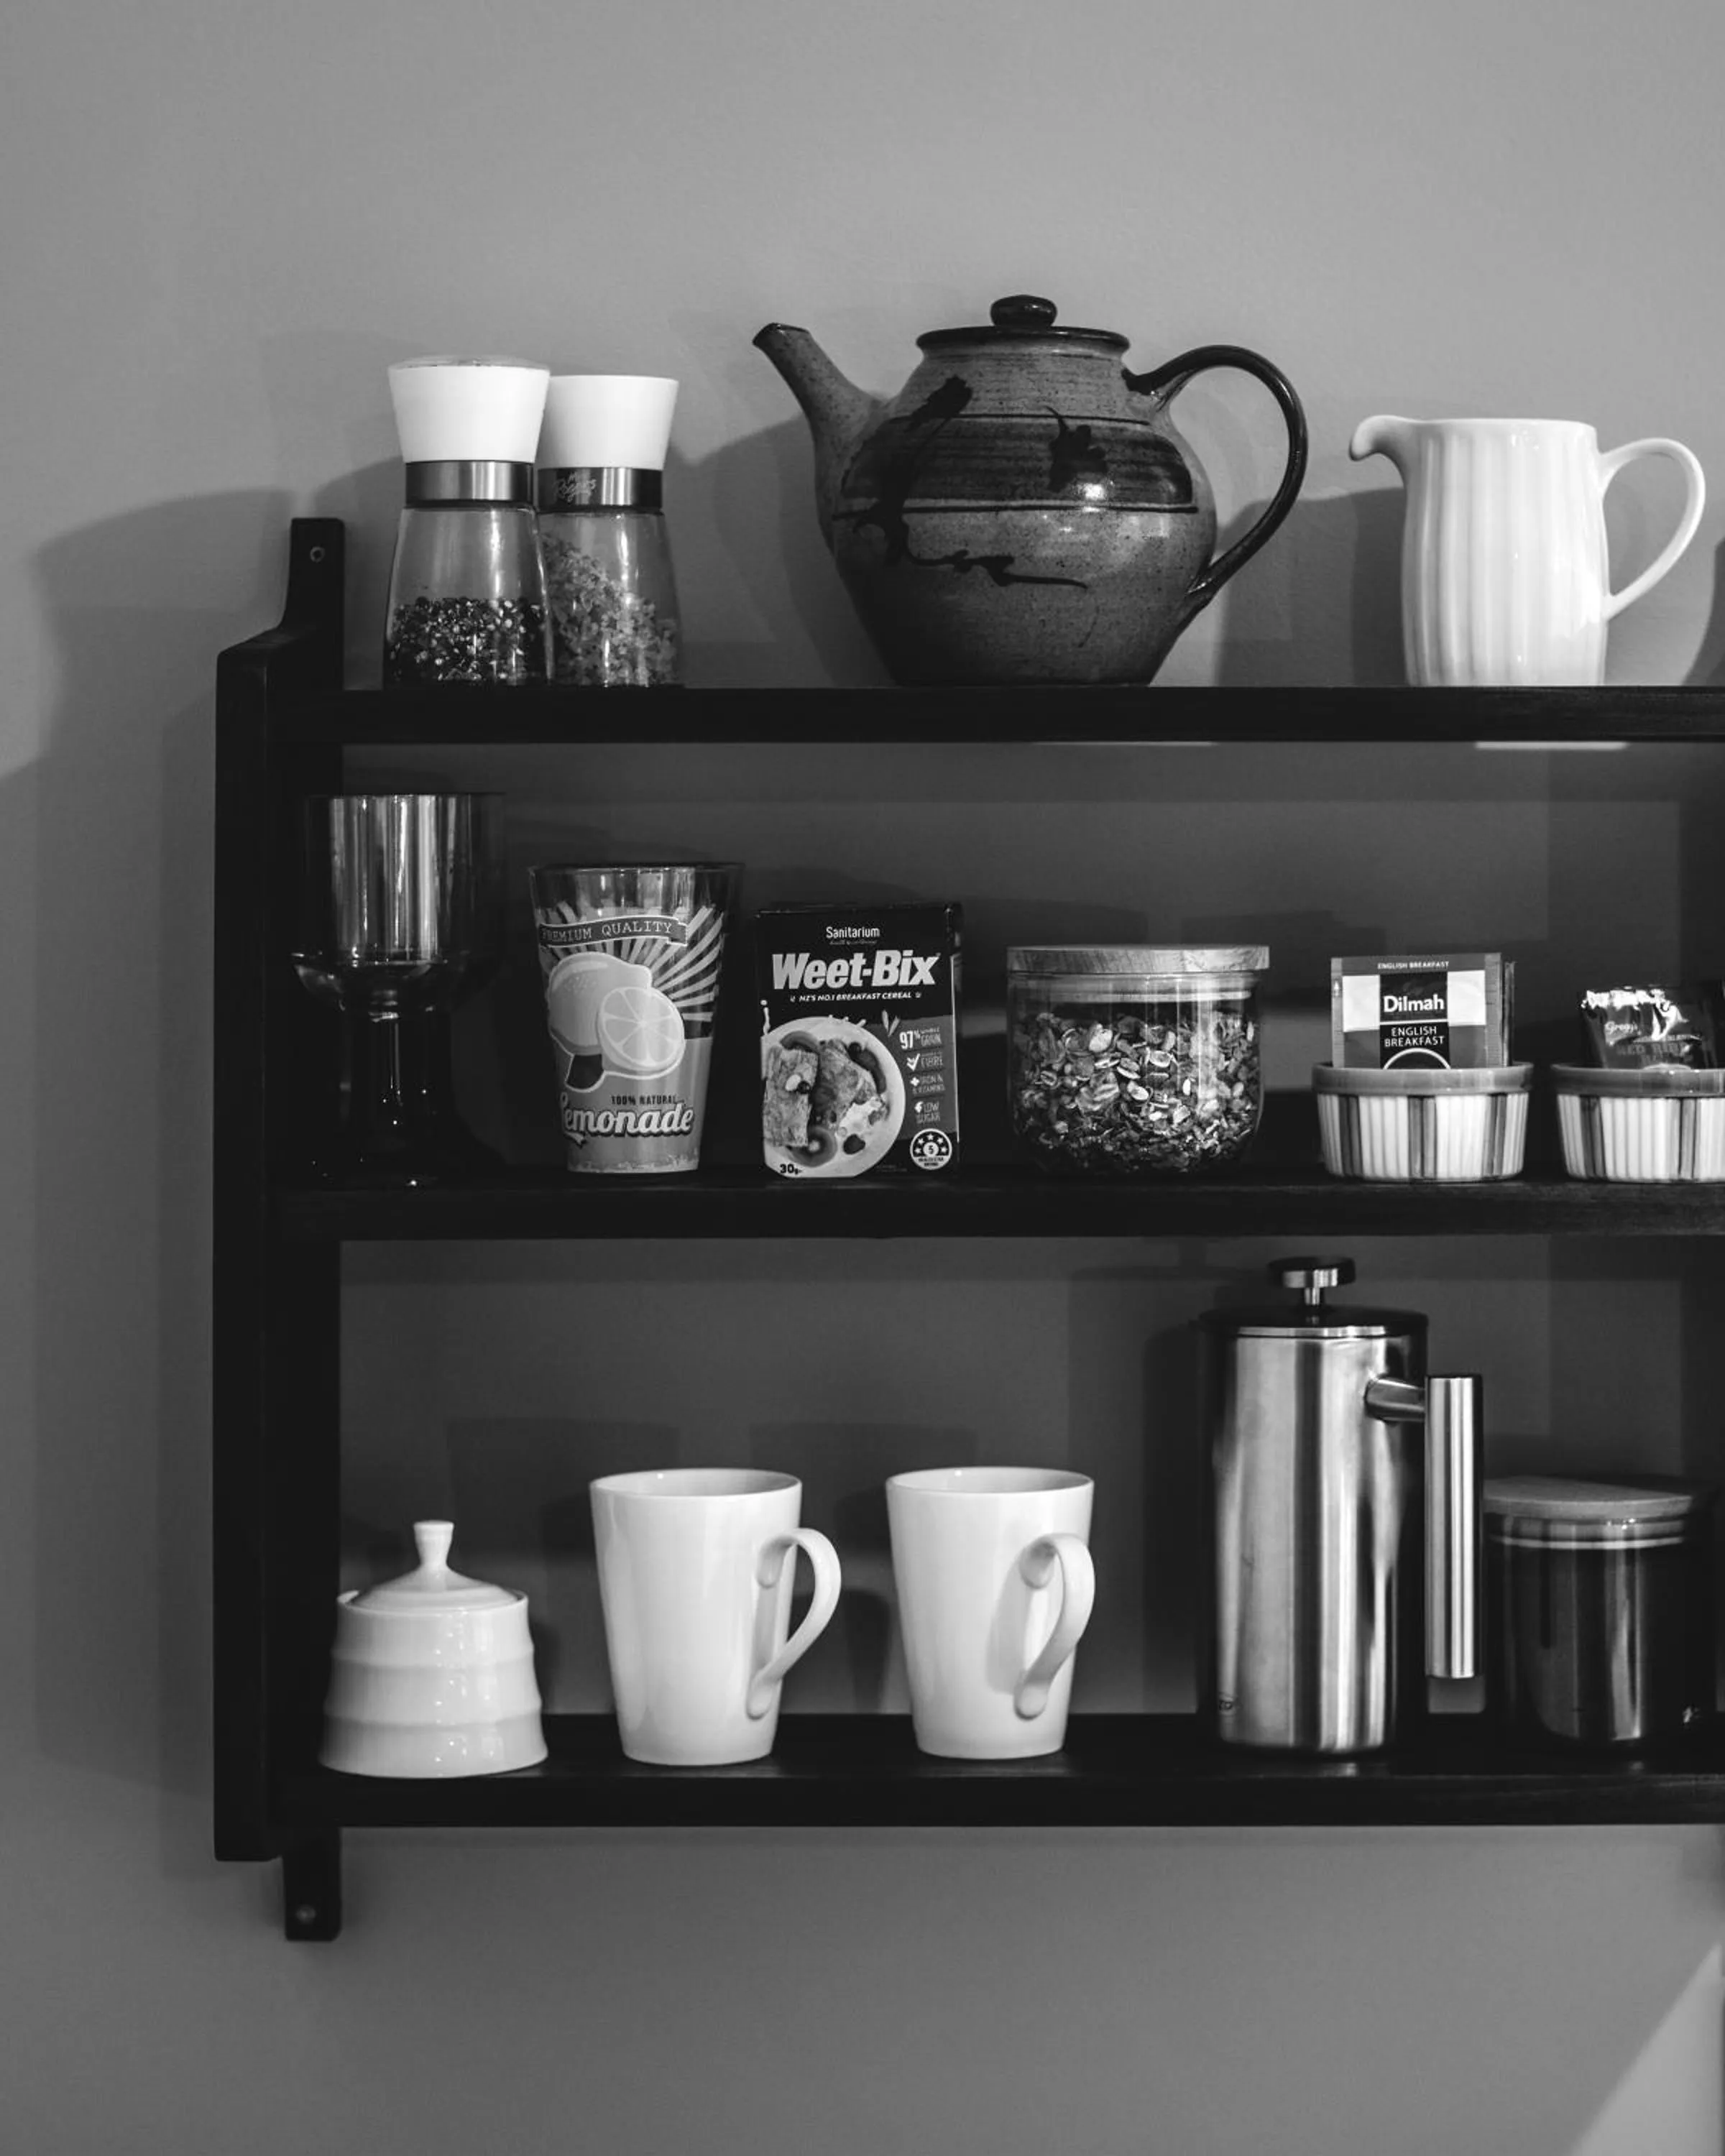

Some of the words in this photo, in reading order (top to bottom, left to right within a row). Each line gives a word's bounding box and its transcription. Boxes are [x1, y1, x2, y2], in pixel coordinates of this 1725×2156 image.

[602, 921, 673, 936] QUALITY
[826, 926, 880, 939] Sanitarium
[772, 949, 940, 990] Weet-Bix
[836, 992, 881, 1001] BREAKFAST
[882, 991, 911, 1000] CEREAL
[1384, 994, 1445, 1013] Dilmah
[1391, 1026, 1437, 1037] ENGLISH
[1384, 1036, 1444, 1047] BREAKFAST
[611, 1095, 635, 1105] 100%
[639, 1095, 676, 1105] NATURAL
[560, 1092, 695, 1146] Lemonade
[928, 1146, 934, 1155] 5
